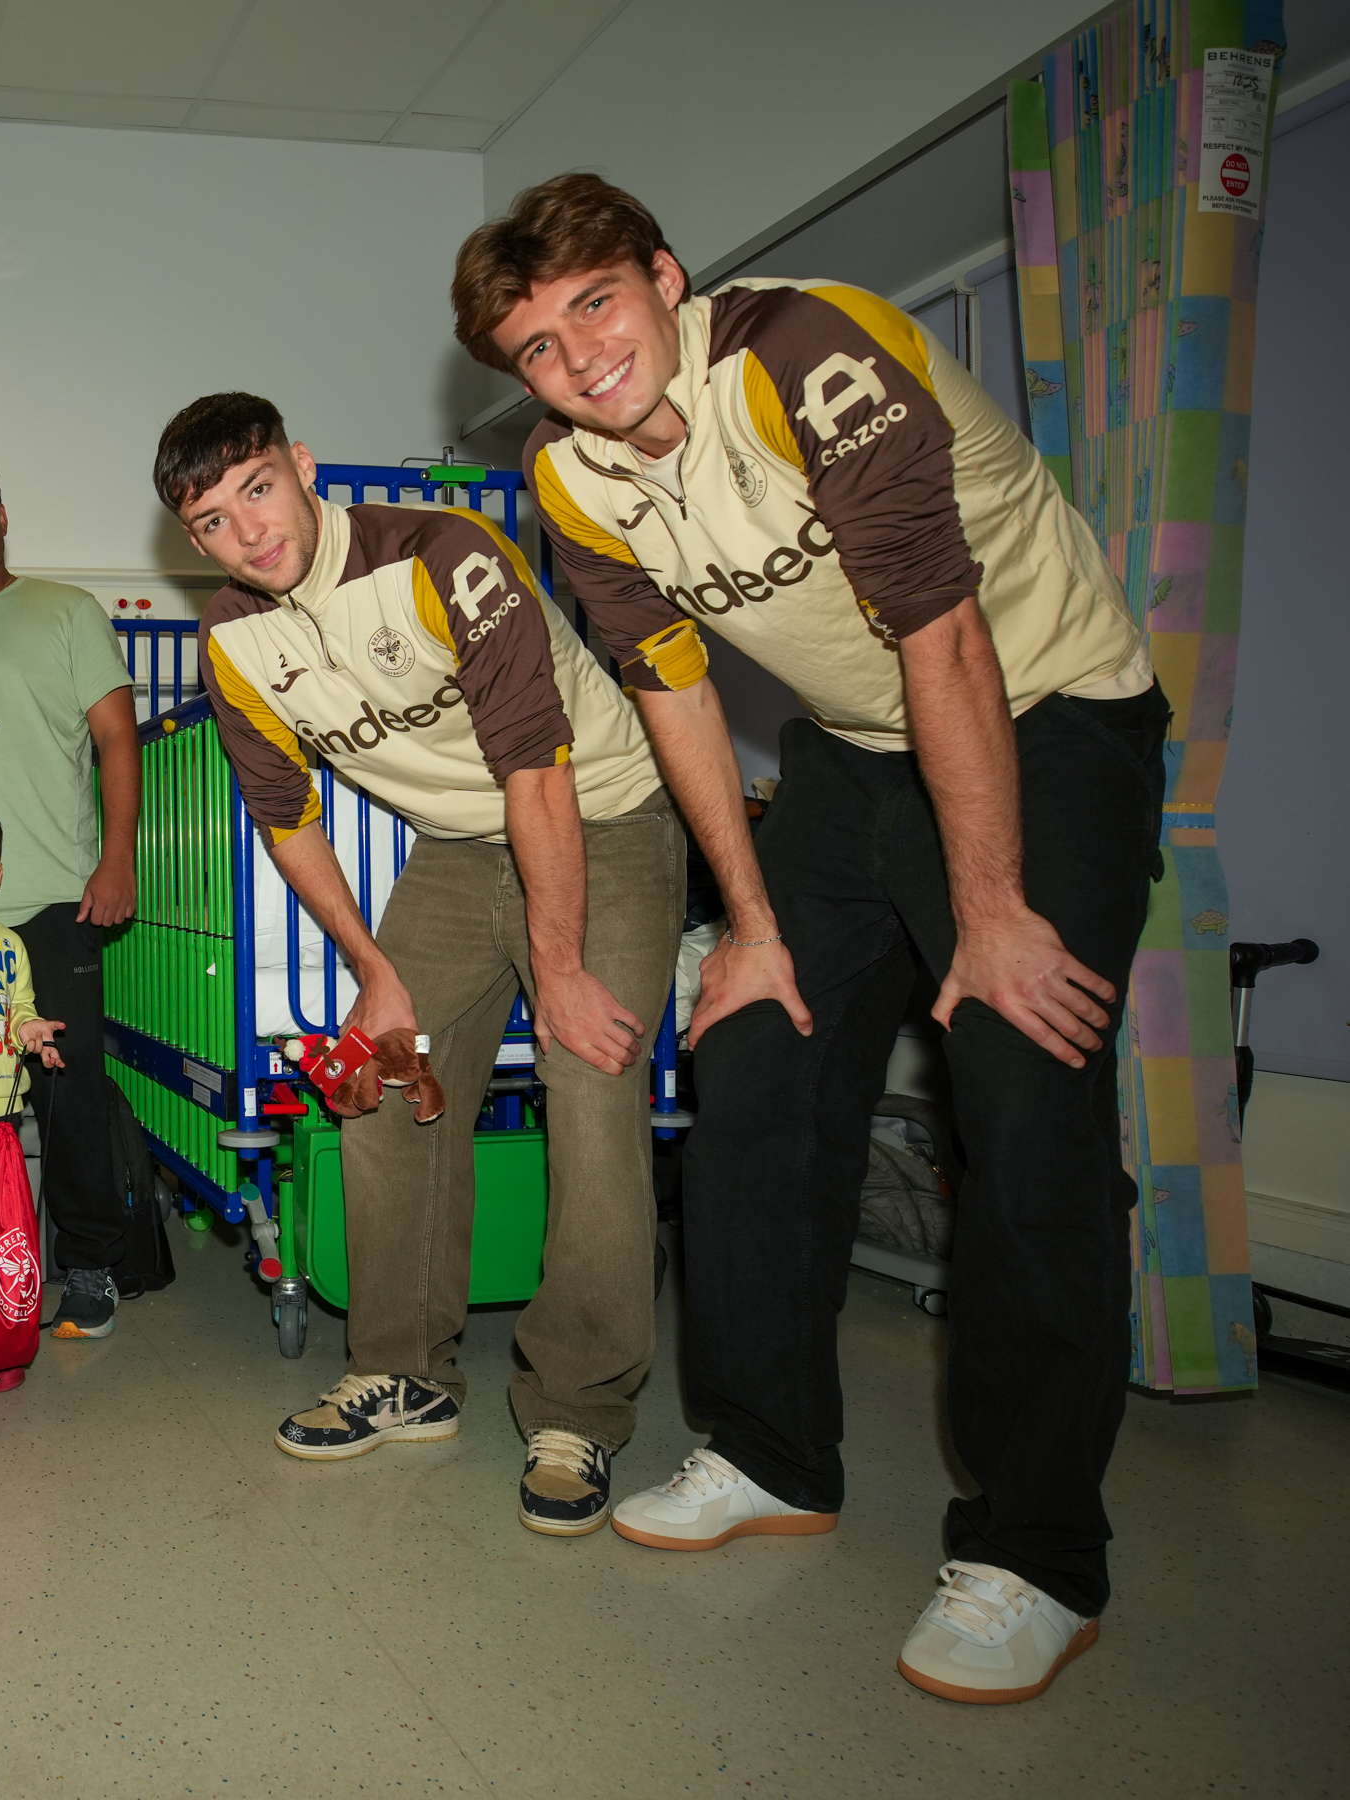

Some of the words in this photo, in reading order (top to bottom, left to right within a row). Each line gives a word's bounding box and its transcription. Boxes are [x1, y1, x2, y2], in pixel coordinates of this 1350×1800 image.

[1207, 51, 1271, 68] BEHRENS
[1203, 142, 1235, 151] RESPECT
[1235, 144, 1243, 152] MY
[1243, 146, 1263, 158] PRIVACY
[1225, 160, 1236, 168] DO
[1236, 161, 1248, 171] NOT
[1226, 180, 1245, 190] ENTER
[1211, 202, 1232, 210] BEFORE
[1232, 204, 1252, 215] ENTERING
[1235, 198, 1258, 209] PERMISSION
[820, 402, 908, 467] CAZOO
[665, 500, 836, 616] ndeed
[278, 653, 289, 669] 2
[296, 674, 465, 755] indeed
[73, 963, 99, 974] HOLLISTER
